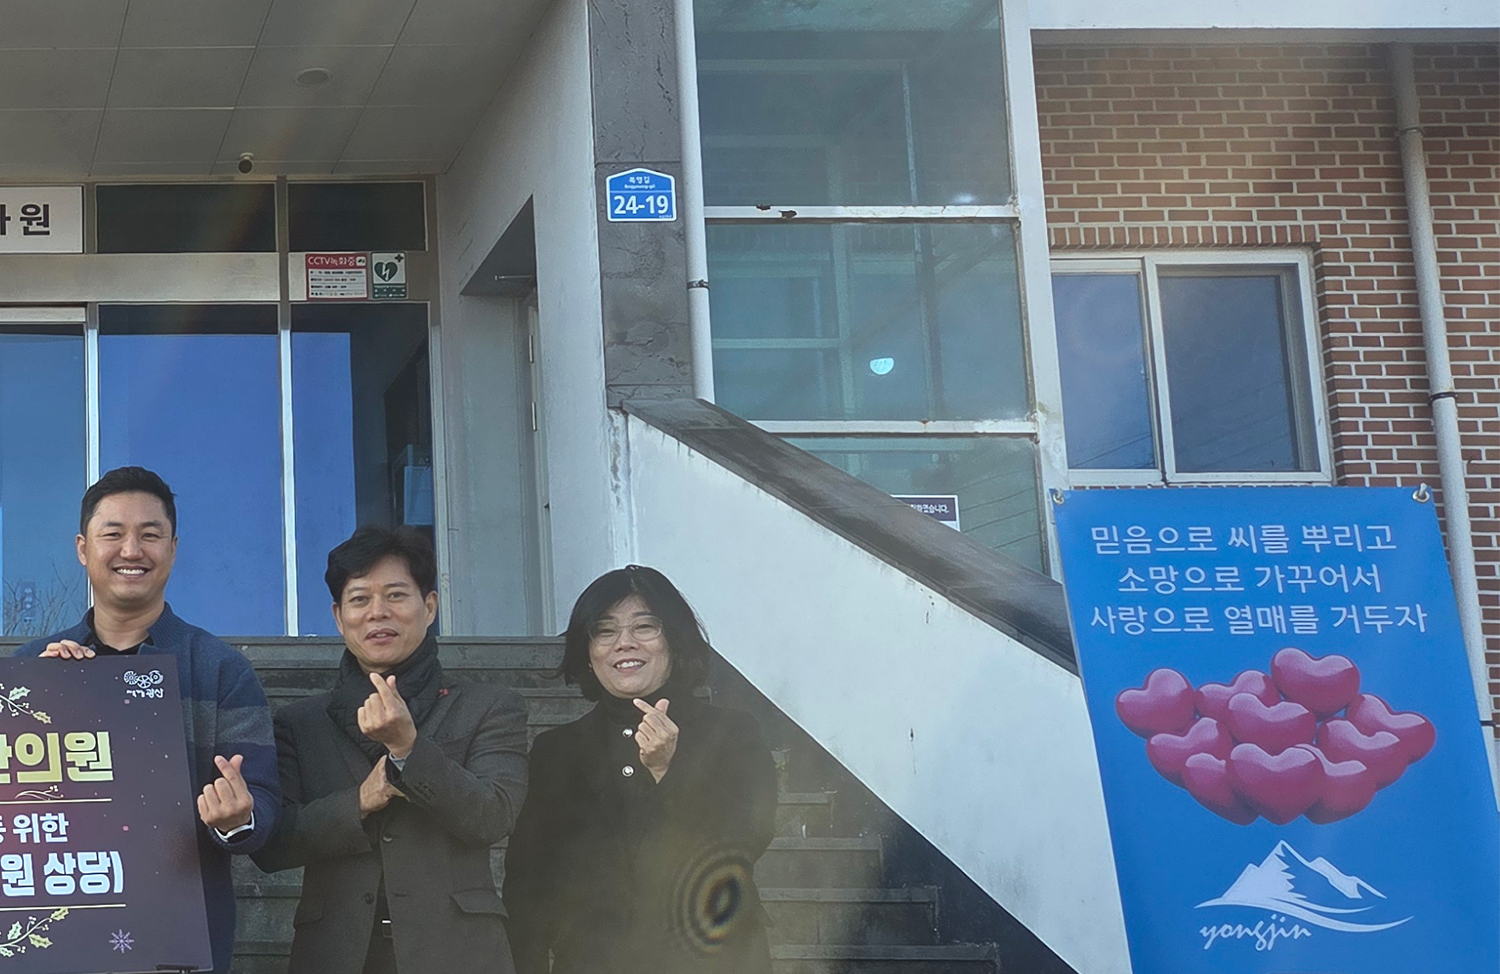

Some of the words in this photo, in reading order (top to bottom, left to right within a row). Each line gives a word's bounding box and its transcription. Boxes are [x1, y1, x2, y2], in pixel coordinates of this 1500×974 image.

[614, 195, 668, 214] 24-19
[1091, 524, 1217, 555] 믿음으로
[1228, 524, 1290, 554] 씨를
[1301, 523, 1397, 554] 뿌리고
[1118, 565, 1245, 594] 소망으로
[1256, 563, 1382, 594] 가꾸어서
[1090, 605, 1215, 636] 사랑으로
[1224, 605, 1320, 636] 열매를
[1329, 604, 1428, 634] 거두자
[12, 812, 70, 844] 위한
[44, 850, 124, 895] 상당)
[1200, 913, 1312, 950] yongjin
